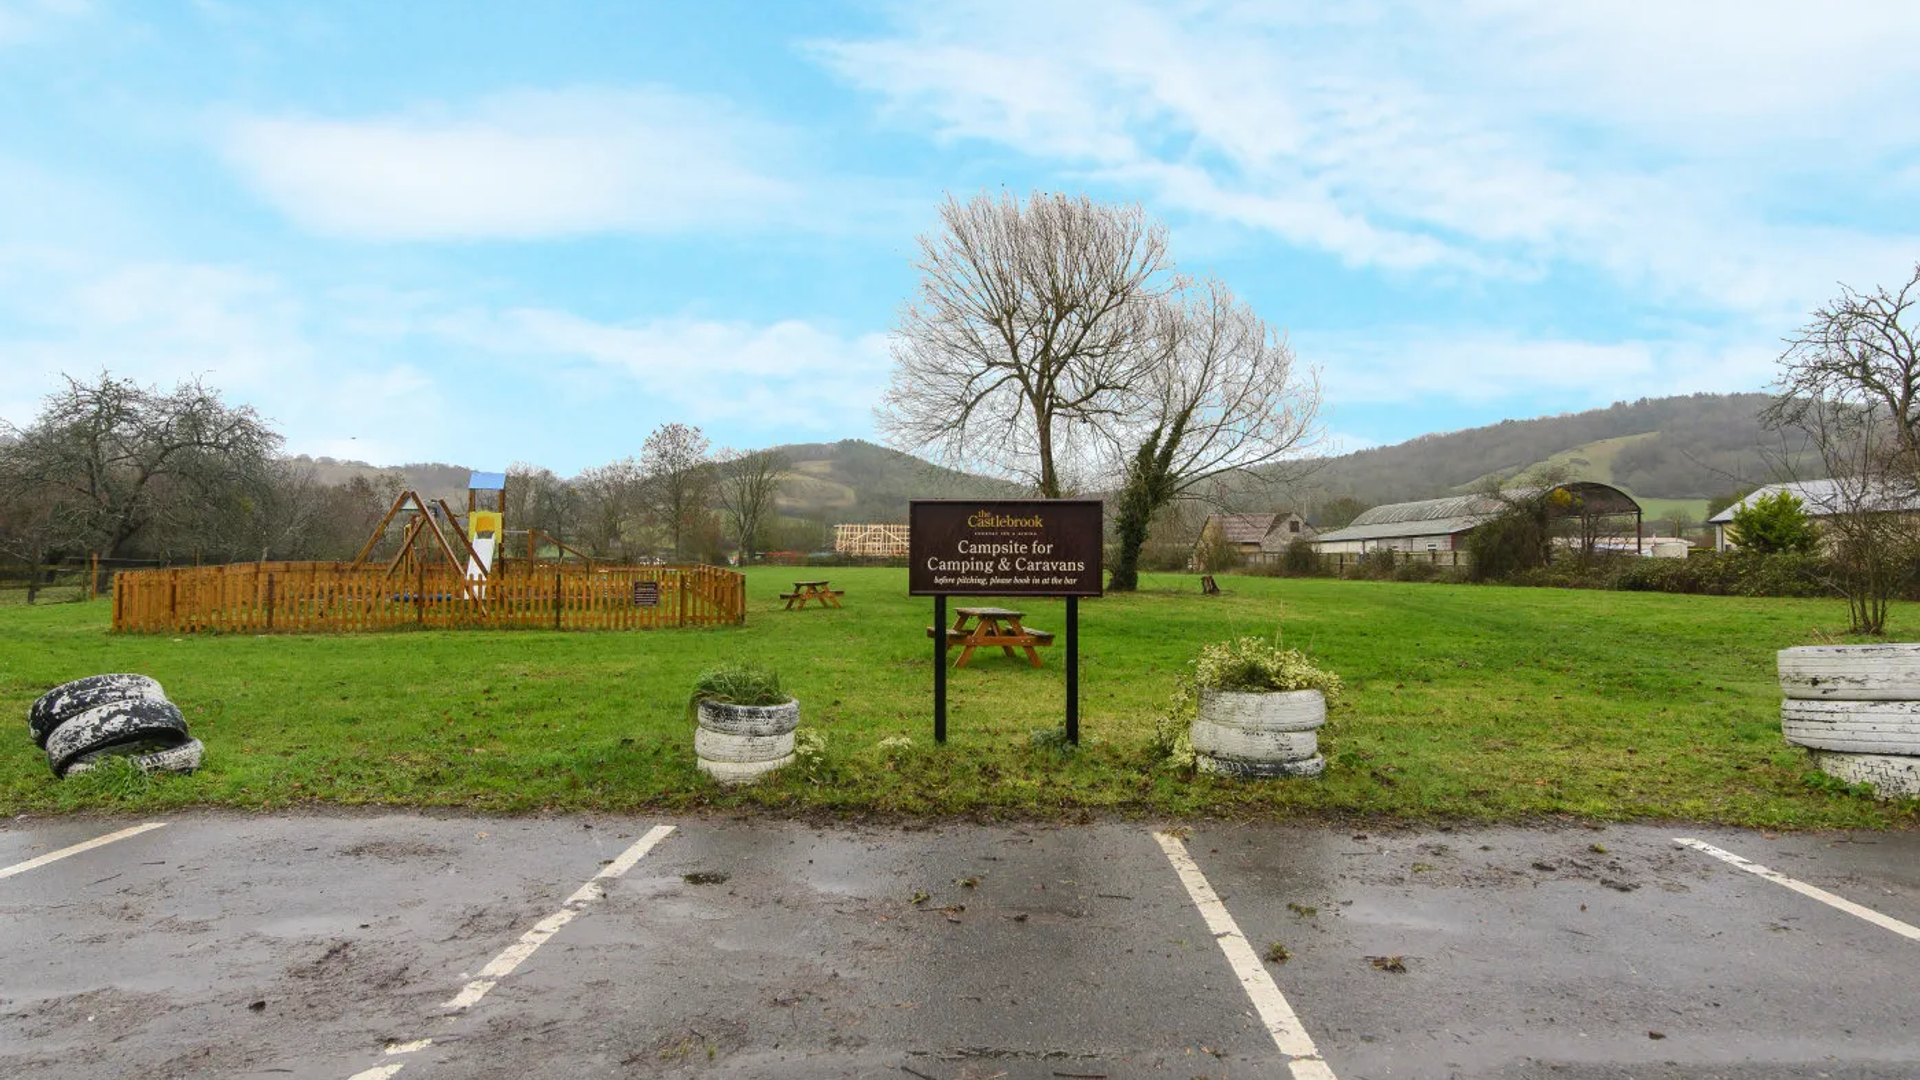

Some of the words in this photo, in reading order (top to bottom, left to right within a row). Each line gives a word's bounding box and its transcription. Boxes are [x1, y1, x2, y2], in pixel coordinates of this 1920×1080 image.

[978, 509, 991, 517] the
[967, 515, 1043, 528] Castlebrook
[958, 540, 1028, 556] Campsite
[1032, 540, 1054, 554] for
[927, 557, 995, 573] Camping
[997, 556, 1011, 571] &
[1015, 557, 1085, 572] Caravans
[934, 575, 955, 585] before
[956, 575, 987, 586] pitching,
[989, 575, 1013, 586] please
[1013, 576, 1030, 584] book
[1032, 576, 1040, 584] in
[1051, 575, 1063, 585] the
[1064, 576, 1077, 584] bar
